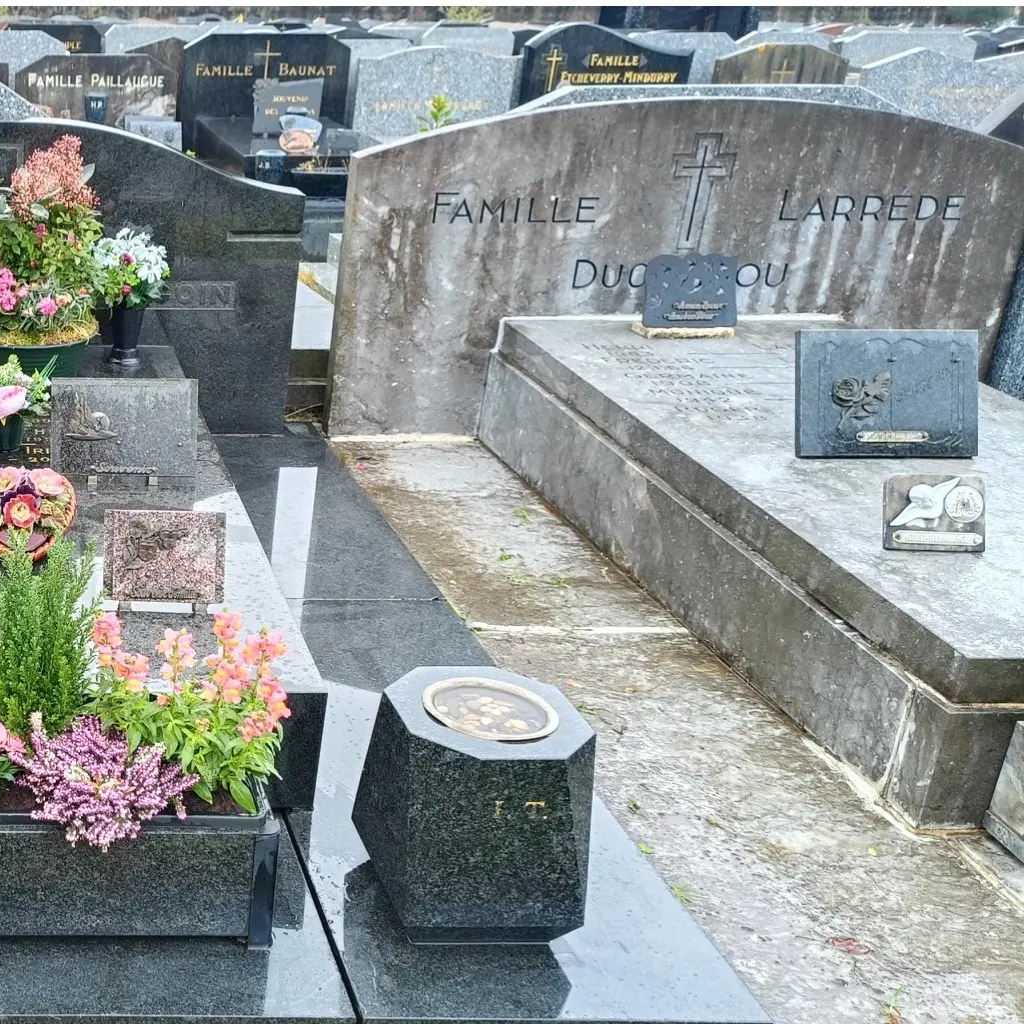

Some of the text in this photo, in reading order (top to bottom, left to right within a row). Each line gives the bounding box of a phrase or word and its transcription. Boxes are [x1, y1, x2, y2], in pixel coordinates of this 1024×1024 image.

[590, 53, 640, 67] FAMILLE
[195, 62, 337, 76] FAMILLE BAUNAT
[28, 72, 83, 88] FAMILLE
[431, 189, 967, 223] FAMILLE LARREDE
[571, 258, 789, 289] DUCOU
